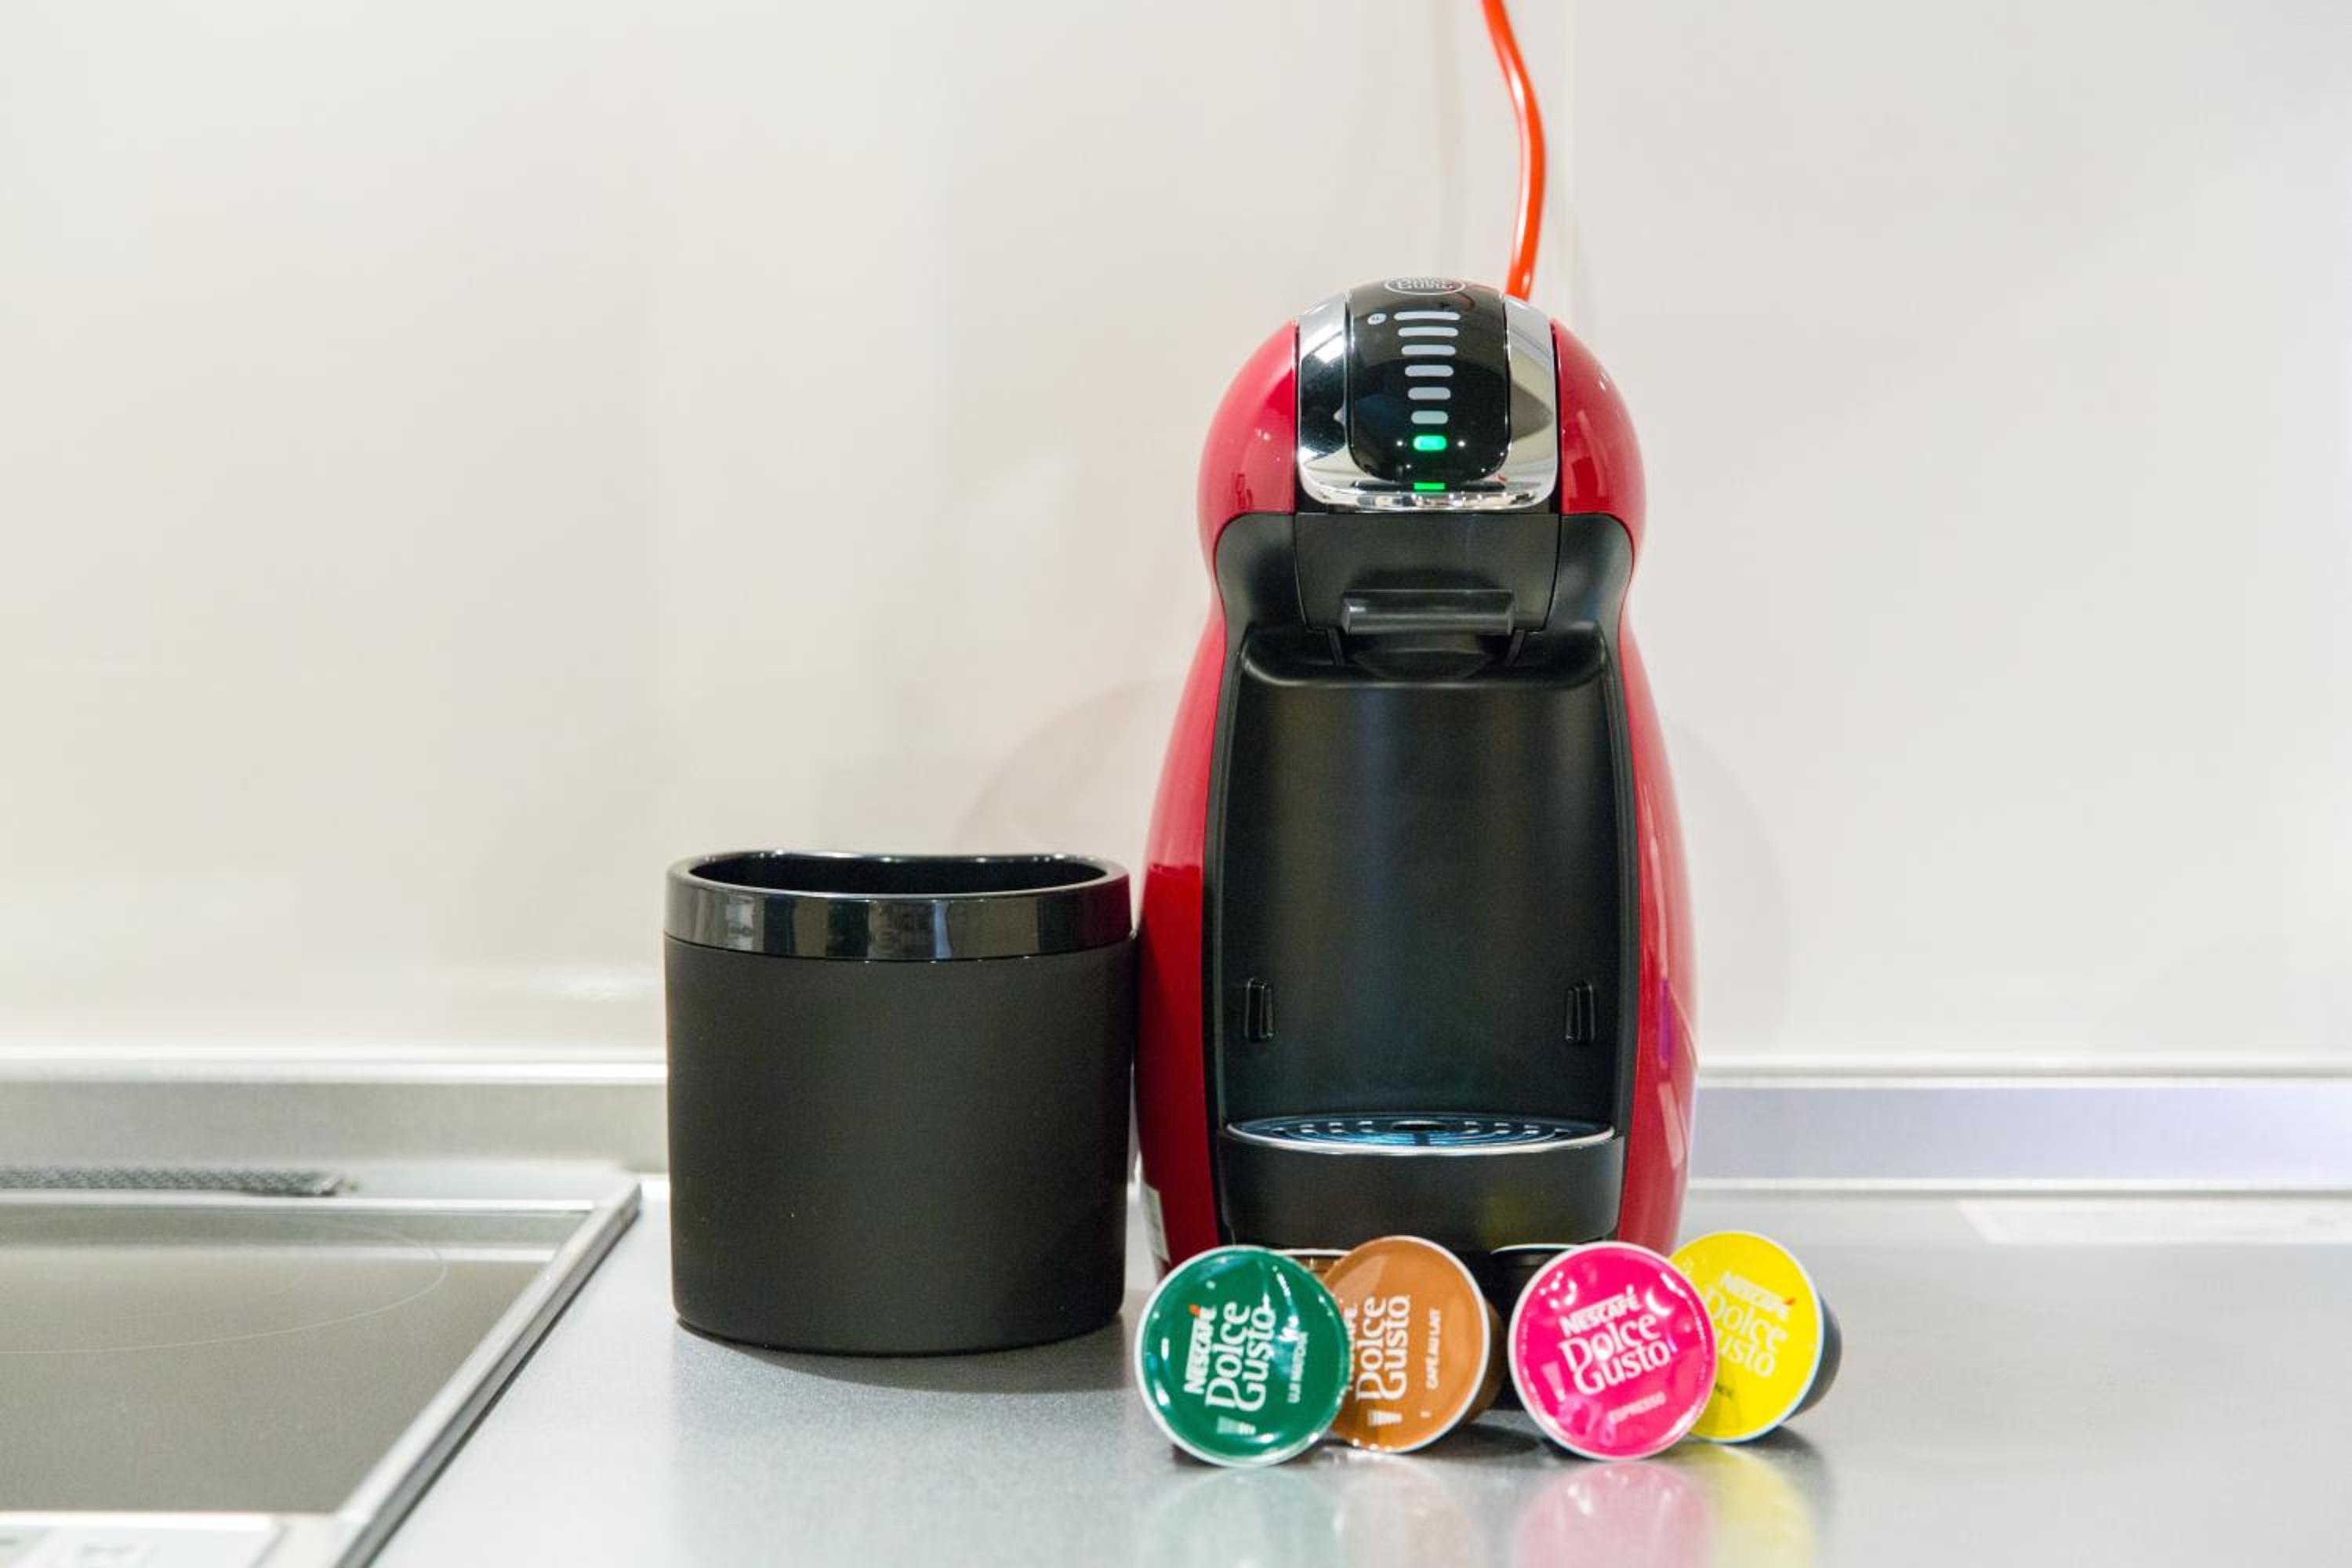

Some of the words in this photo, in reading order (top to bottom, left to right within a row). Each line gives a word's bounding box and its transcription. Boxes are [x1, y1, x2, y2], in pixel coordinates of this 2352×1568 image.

[1204, 1301, 1251, 1409] Dolce
[1236, 1306, 1276, 1411] Gusto
[1356, 1296, 1386, 1401] Dolce
[1381, 1295, 1410, 1401] Gusto
[1558, 1314, 1661, 1372] Dolce
[1707, 1287, 1788, 1354] Dolce
[1715, 1329, 1776, 1377] usto
[1573, 1341, 1671, 1396] Gusto
